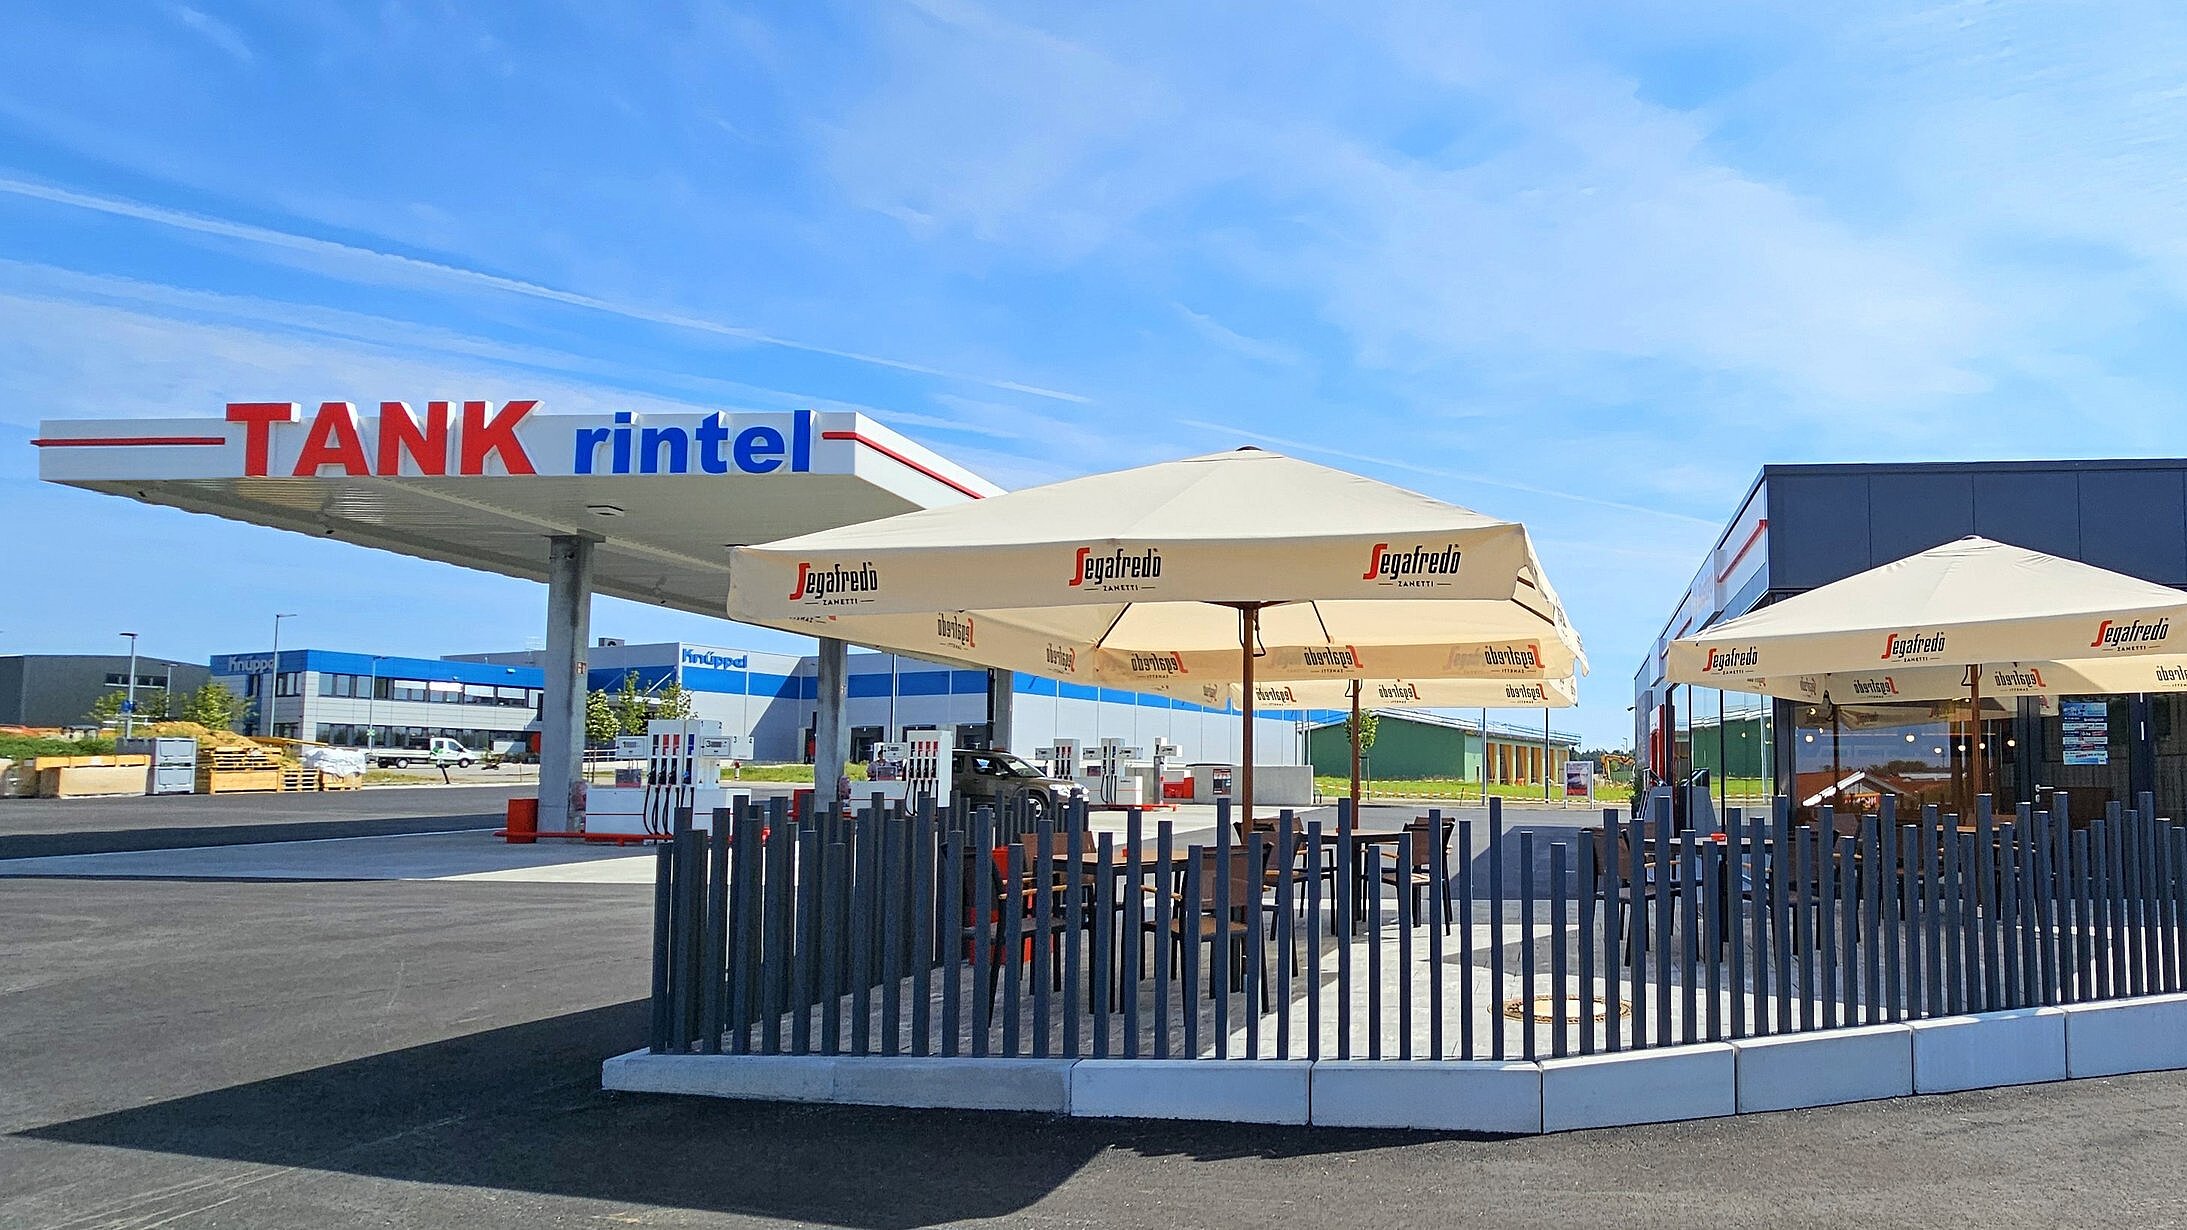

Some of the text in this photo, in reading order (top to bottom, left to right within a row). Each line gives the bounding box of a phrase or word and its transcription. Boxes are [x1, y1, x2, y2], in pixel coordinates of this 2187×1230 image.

[226, 400, 811, 476] TANK rintel
[822, 598, 858, 606] ZANETTI
